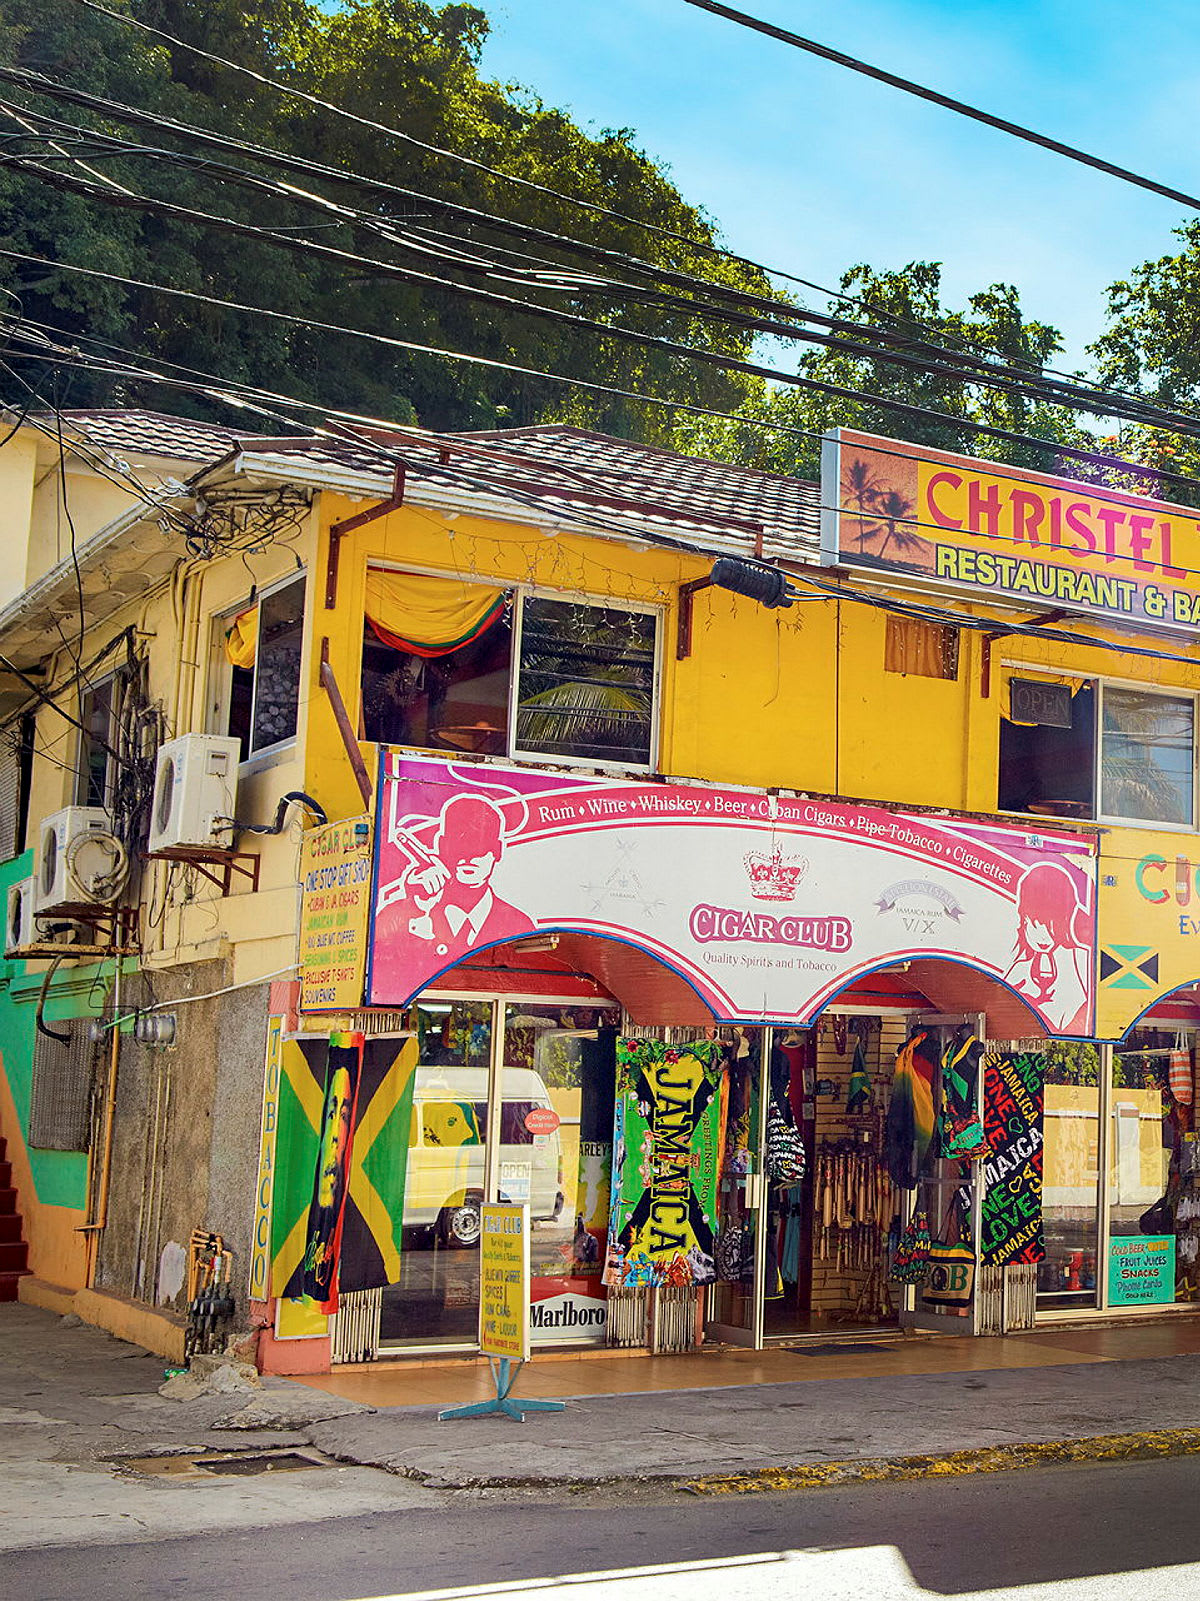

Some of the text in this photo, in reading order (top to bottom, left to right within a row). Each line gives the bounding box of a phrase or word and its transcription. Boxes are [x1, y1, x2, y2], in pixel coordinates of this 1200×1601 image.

[935, 543, 1137, 612] RESTAURANT
[1143, 584, 1168, 619] &
[538, 803, 576, 824] Rum
[586, 798, 628, 818] Wine
[637, 794, 702, 817] Whiskey
[714, 796, 748, 815] Beer
[804, 806, 846, 827] Cigars
[888, 822, 943, 854] Tobacco
[952, 846, 1012, 885] Cigarettes
[691, 904, 851, 950] CIGAR CLUB
[703, 951, 837, 972] Quality Spirits and Tobacco
[996, 1060, 1039, 1126] JAMAICA
[254, 1028, 279, 1287] TOBACCO
[502, 1162, 530, 1178] OPEN
[650, 1066, 696, 1255] JAMAICA
[699, 1111, 715, 1209] GREETINGS FROM
[959, 1127, 1043, 1210] JMAICA
[981, 1192, 1040, 1252] LOVE
[992, 1215, 1044, 1266] JAMAIC
[1120, 1255, 1168, 1267] FRUIT JUICES
[1121, 1268, 1160, 1279] SNACKS
[530, 1300, 606, 1328] Marlboro
